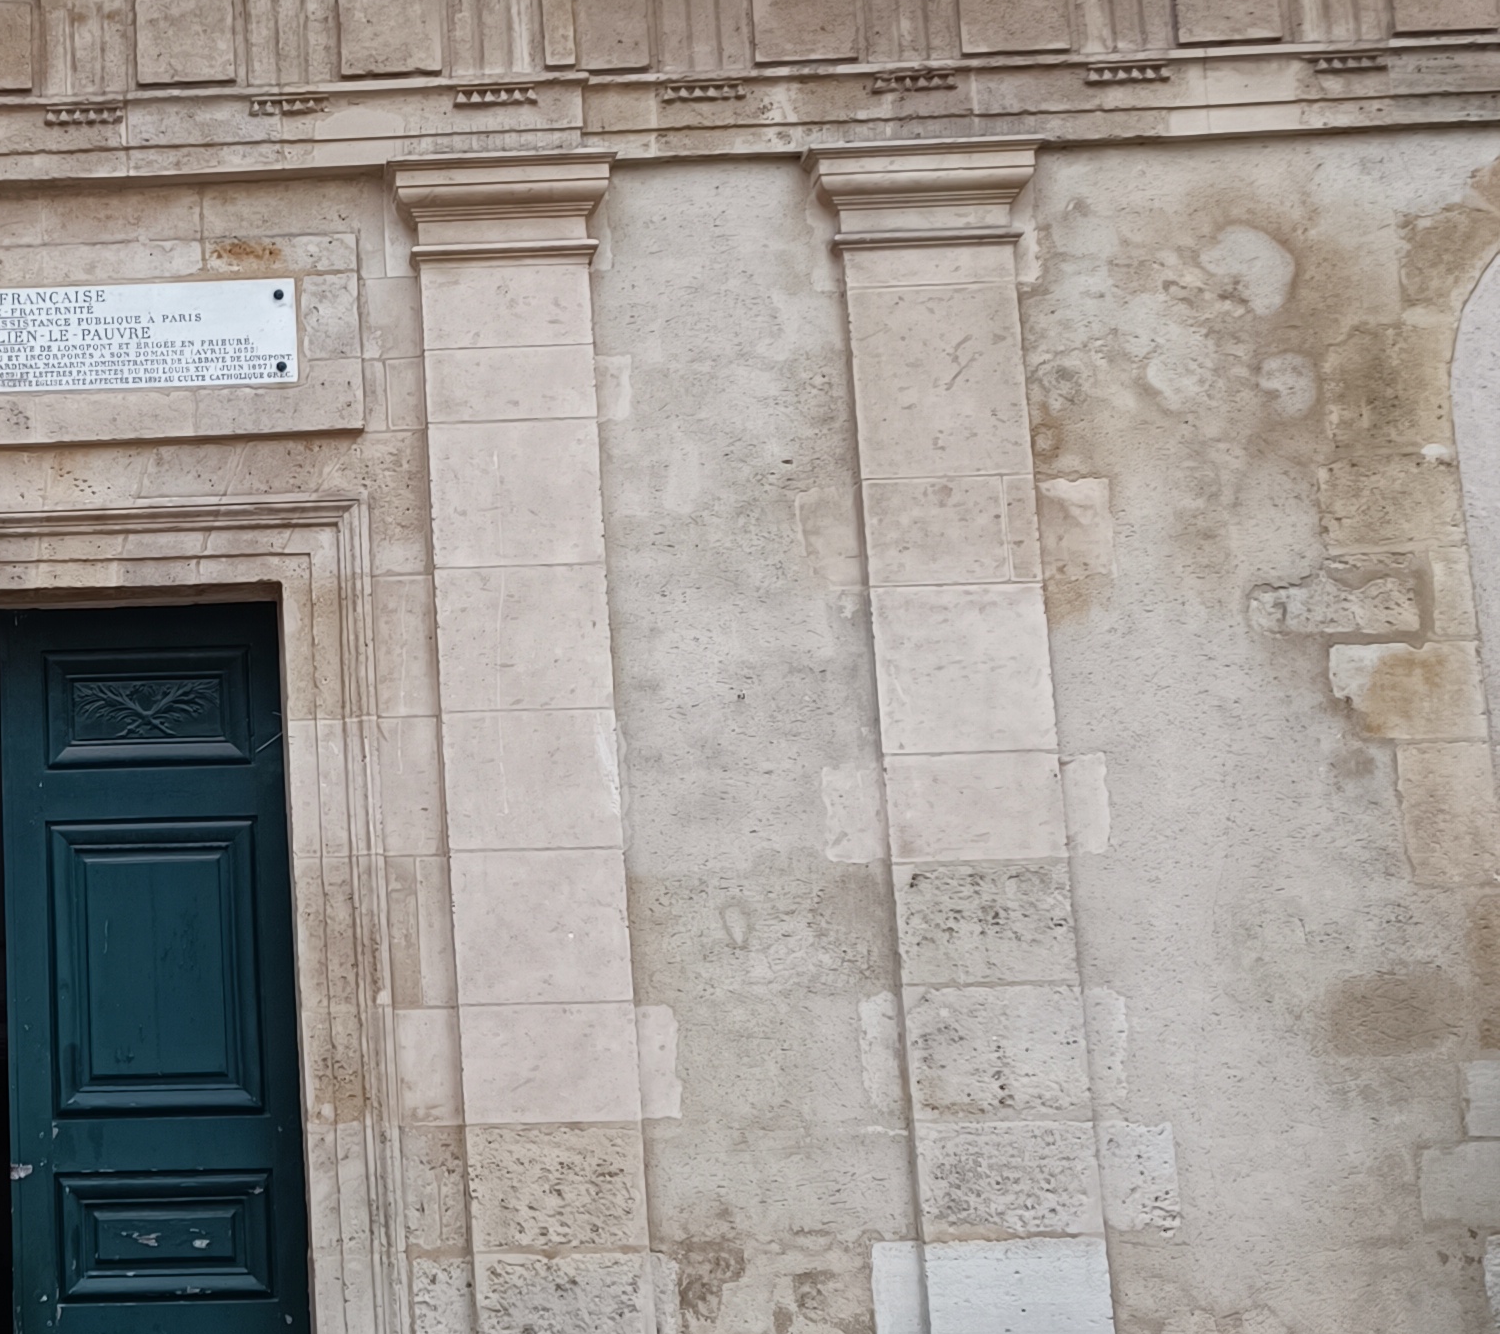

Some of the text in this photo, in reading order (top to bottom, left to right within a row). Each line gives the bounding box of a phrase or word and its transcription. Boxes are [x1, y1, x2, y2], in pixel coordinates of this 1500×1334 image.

[0, 290, 106, 306] FRANÇAISE
[77, 315, 142, 327] PUBLIQUE
[147, 312, 155, 324] À
[162, 313, 202, 323] PARIS
[57, 343, 113, 352] LONGPONT
[136, 339, 176, 349] ÉRIGÉE
[180, 340, 195, 348] EN
[25, 352, 94, 361] INCORPORÉS
[109, 351, 130, 359] SON
[135, 349, 185, 358] DOMAINE
[88, 358, 168, 368] ADMINISTRATEUR
[230, 355, 242, 363] DE
[33, 370, 73, 378] LETTRES
[76, 368, 124, 377] PATENTES
[162, 366, 190, 375] LOUIS
[178, 374, 206, 382] CULTE
